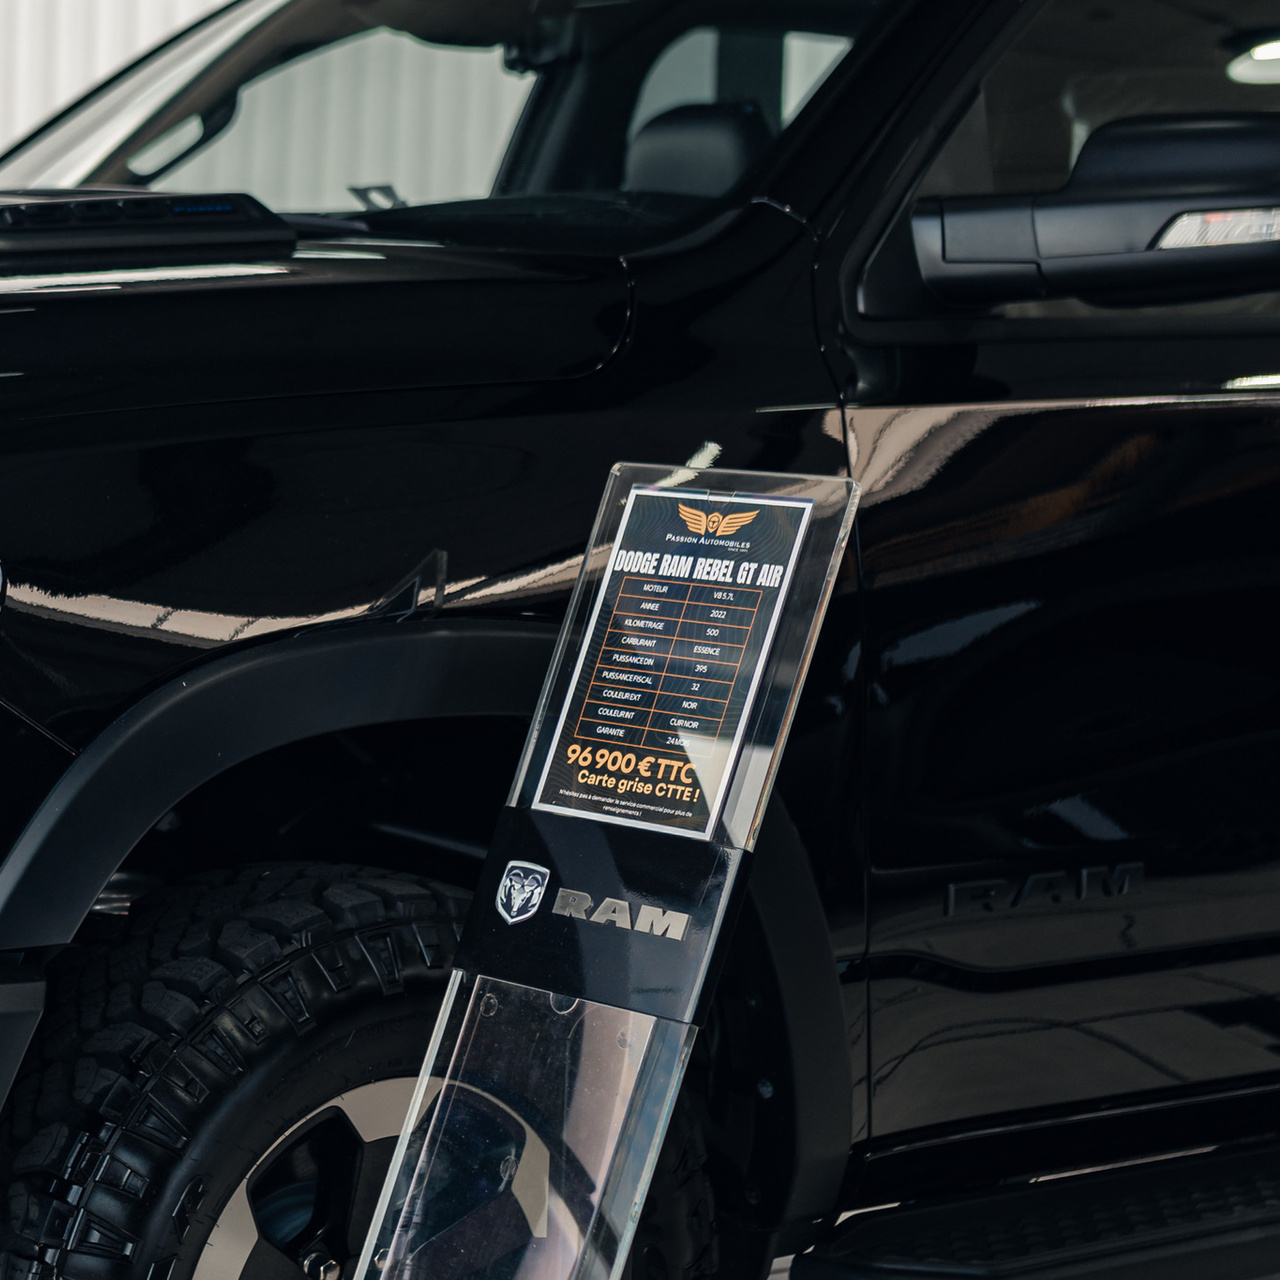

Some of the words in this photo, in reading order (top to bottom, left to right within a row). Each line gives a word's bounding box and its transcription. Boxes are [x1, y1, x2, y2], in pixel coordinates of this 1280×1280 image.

[666, 533, 698, 544] PASSION
[699, 537, 751, 549] AUTOMOBILES
[614, 549, 661, 575] DODGE
[658, 554, 694, 578] RAM
[692, 557, 735, 583] REBEL
[736, 562, 759, 585] GT
[756, 564, 784, 588] AIR
[643, 584, 669, 593] MOTEUR
[713, 591, 723, 600] V8
[710, 610, 727, 619] 2022
[624, 619, 665, 631] KILOMETRAGE
[706, 628, 719, 637] 500
[621, 636, 657, 648] CARBURANT
[693, 645, 720, 656] ESSENCE
[612, 653, 645, 664] PUISSANCE
[694, 664, 708, 673] 395
[602, 670, 633, 682] PUISSANCE
[691, 683, 700, 691] 32
[602, 689, 630, 700] COULEUR
[682, 700, 698, 710] NOIR
[598, 707, 625, 718] COULEUR
[669, 718, 684, 727] CUIR
[682, 720, 699, 729] NOIR
[596, 726, 625, 737] GARANTIE
[666, 737, 675, 745] 24
[566, 744, 593, 767] 96
[594, 748, 637, 774] 900
[637, 756, 656, 777] €
[656, 758, 697, 784] TTC
[577, 769, 616, 789] Carte
[617, 777, 653, 794] grise
[655, 782, 694, 801] CTTE
[591, 794, 615, 803] demander
[619, 800, 636, 808] service
[636, 803, 664, 812] commercial
[943, 861, 1145, 917] RAM
[552, 887, 692, 942] RAM
